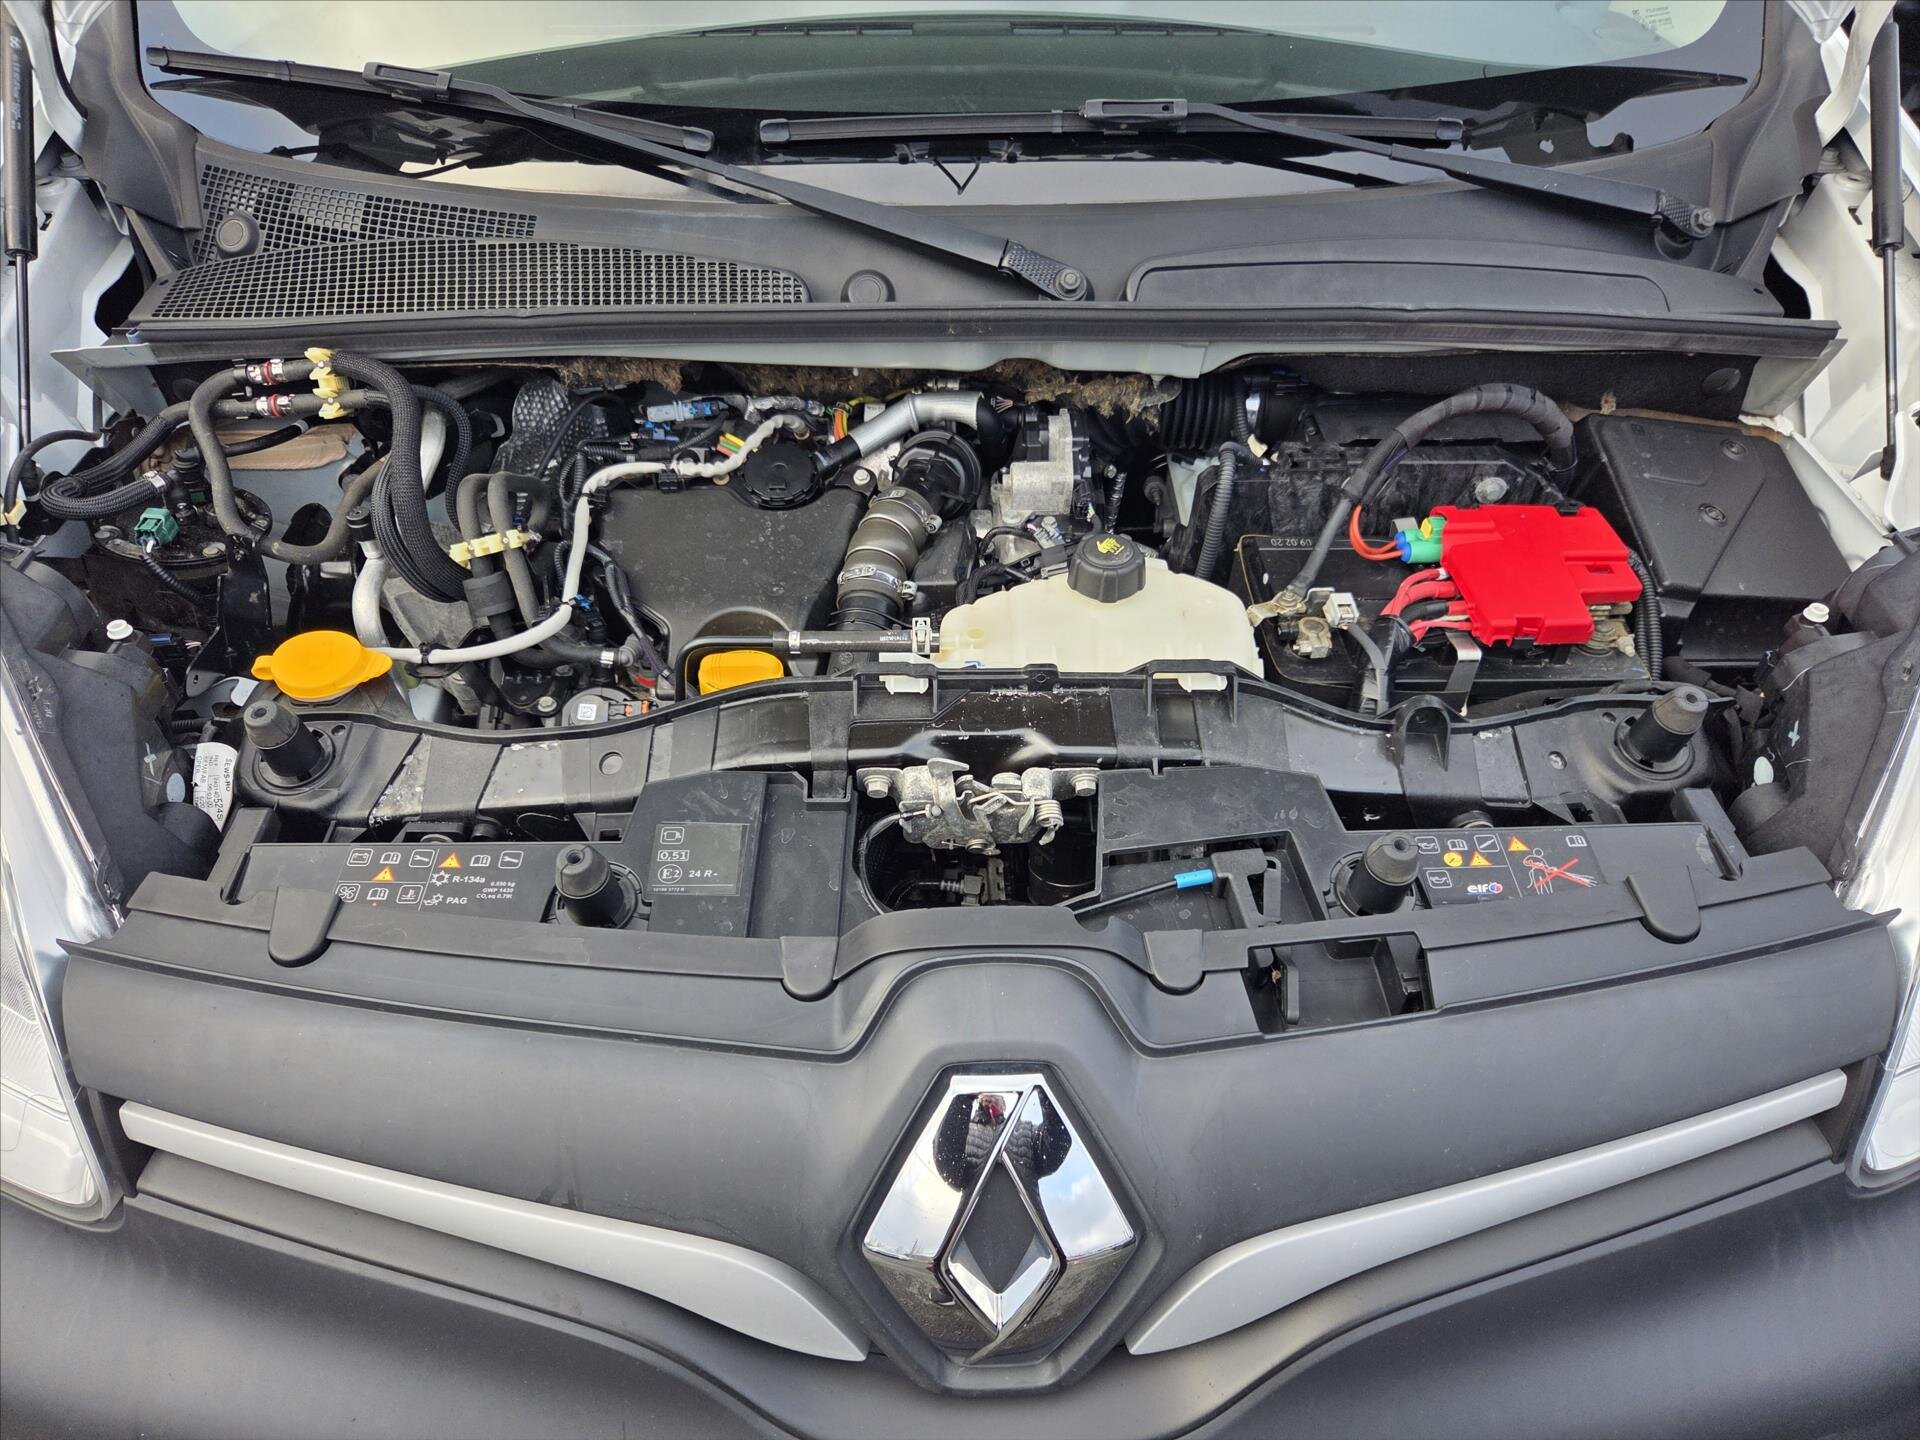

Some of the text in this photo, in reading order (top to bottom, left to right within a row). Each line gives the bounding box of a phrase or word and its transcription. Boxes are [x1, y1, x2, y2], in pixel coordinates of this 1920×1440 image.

[660, 851, 686, 861] 0,51
[662, 868, 680, 879] E2
[688, 870, 701, 878] 24
[452, 875, 486, 883] R-134a
[1467, 883, 1489, 893] elf
[446, 896, 468, 904] PAG
